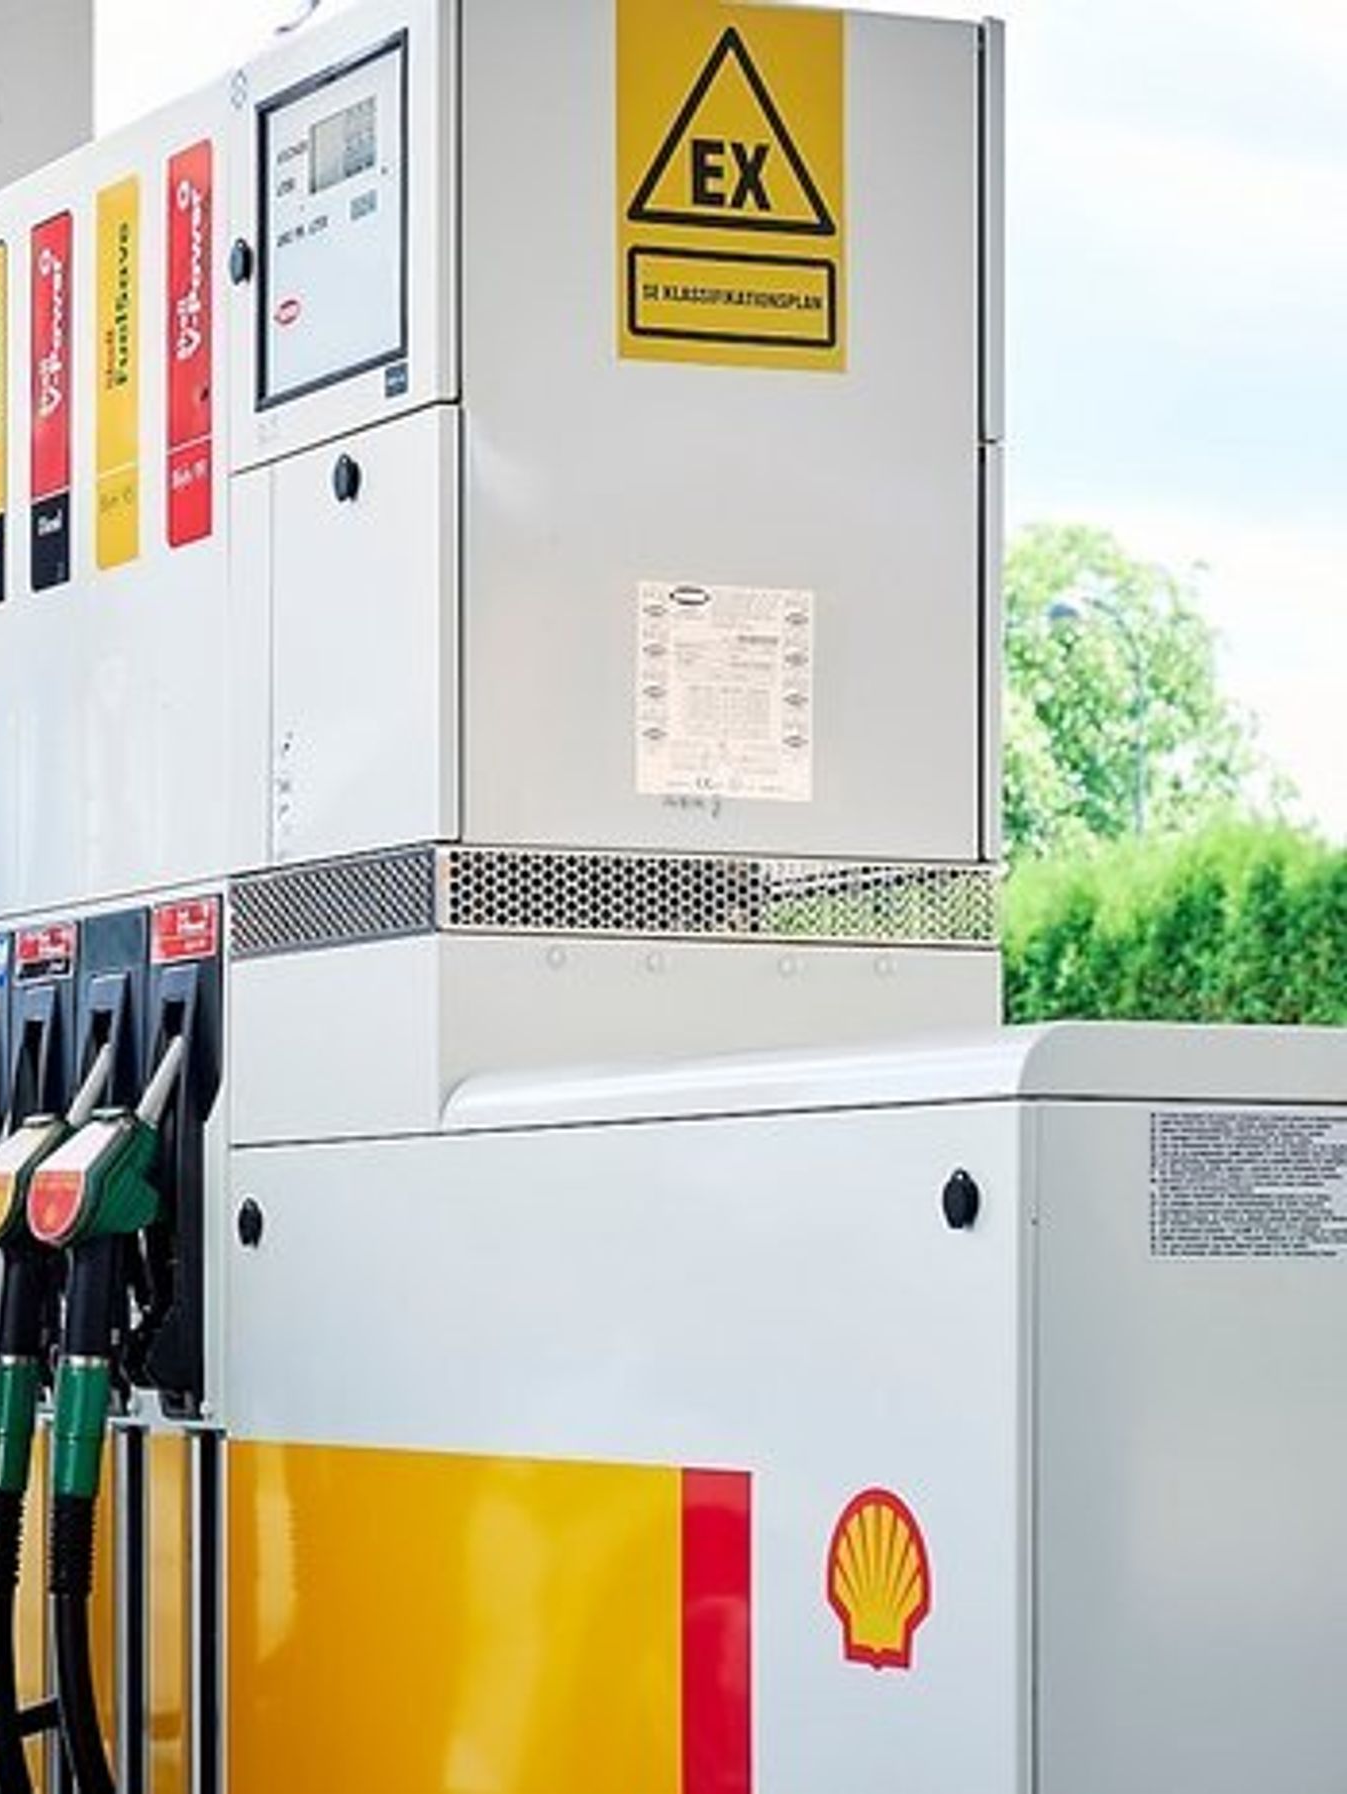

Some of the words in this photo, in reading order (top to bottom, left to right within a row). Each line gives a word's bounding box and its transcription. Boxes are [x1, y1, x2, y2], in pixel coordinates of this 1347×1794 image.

[690, 138, 772, 211] EX
[115, 223, 129, 386] FuelSave
[662, 284, 823, 310] KLASSIFIKATIONSPLAN
